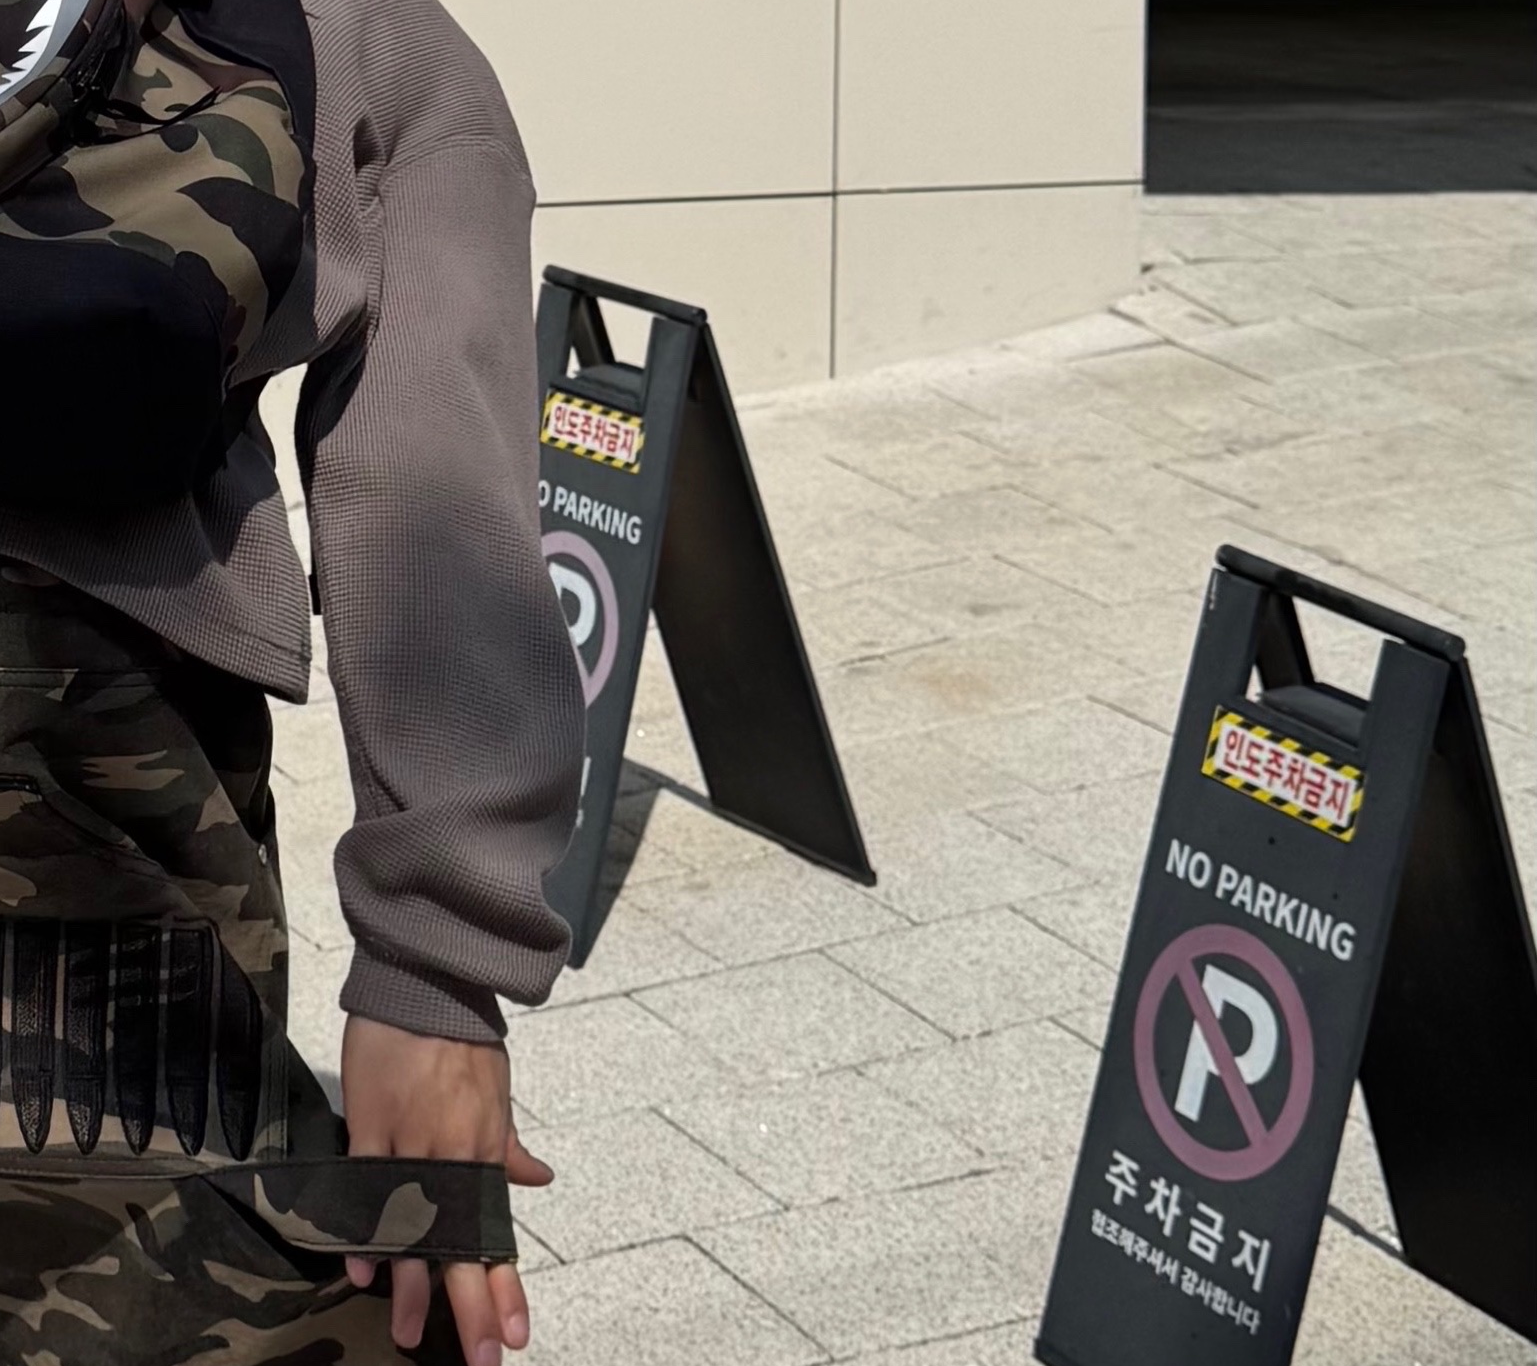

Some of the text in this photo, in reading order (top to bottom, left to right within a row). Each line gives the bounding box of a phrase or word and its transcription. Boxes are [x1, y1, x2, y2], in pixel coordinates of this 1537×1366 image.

[552, 405, 636, 459] 인도주차금지
[538, 480, 642, 545] O PARKING
[1223, 730, 1351, 822] 인도주차금지
[1165, 838, 1357, 962] NO PARKING
[1104, 1149, 1271, 1294] 주차금지
[1180, 1265, 1262, 1336] 감사합니다
